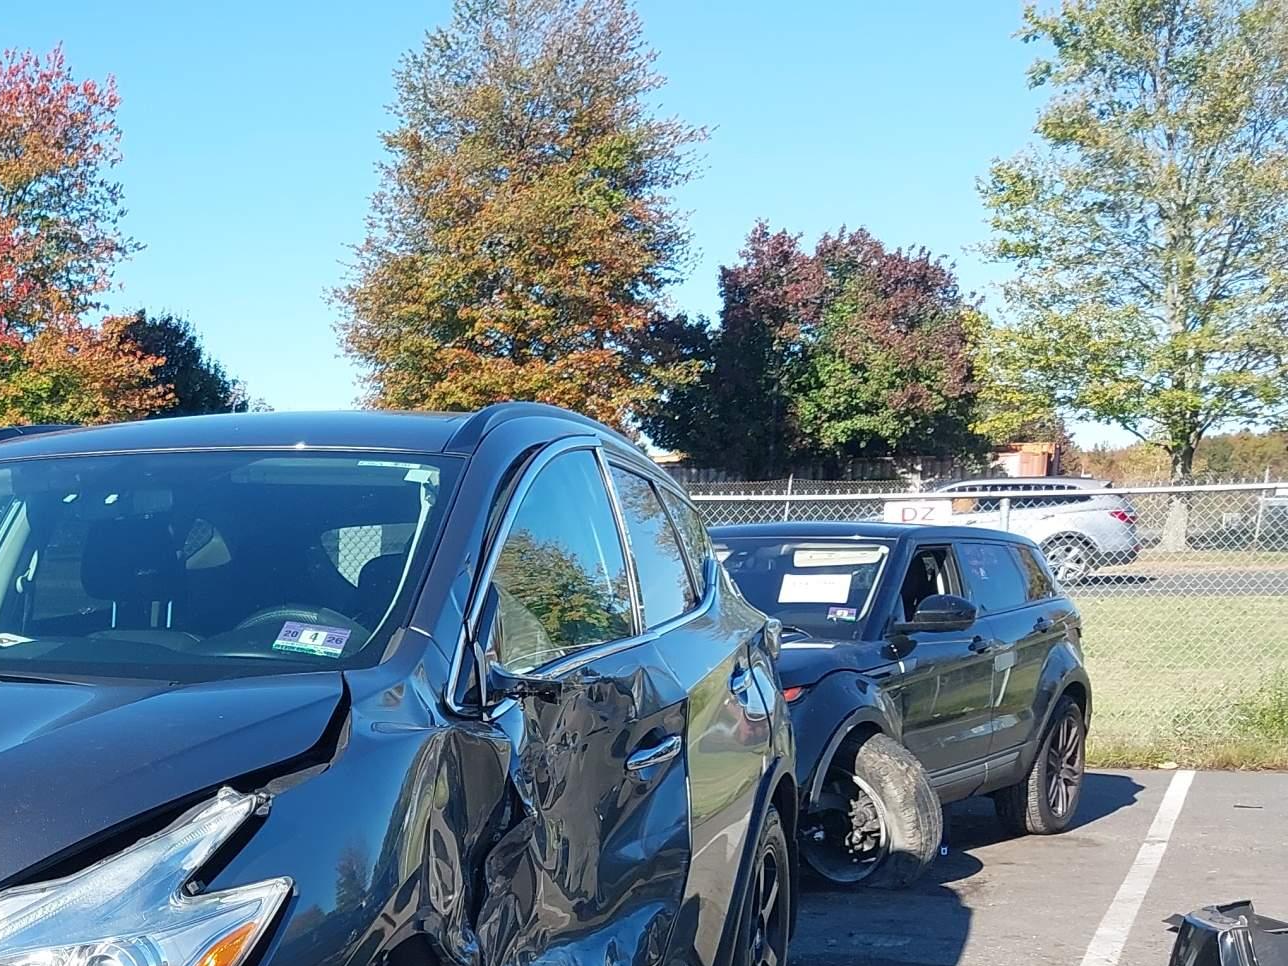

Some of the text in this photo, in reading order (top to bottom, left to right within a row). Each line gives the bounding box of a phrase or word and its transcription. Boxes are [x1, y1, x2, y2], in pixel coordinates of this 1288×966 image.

[901, 506, 935, 523] DZ
[283, 630, 343, 645] 20 4 26
